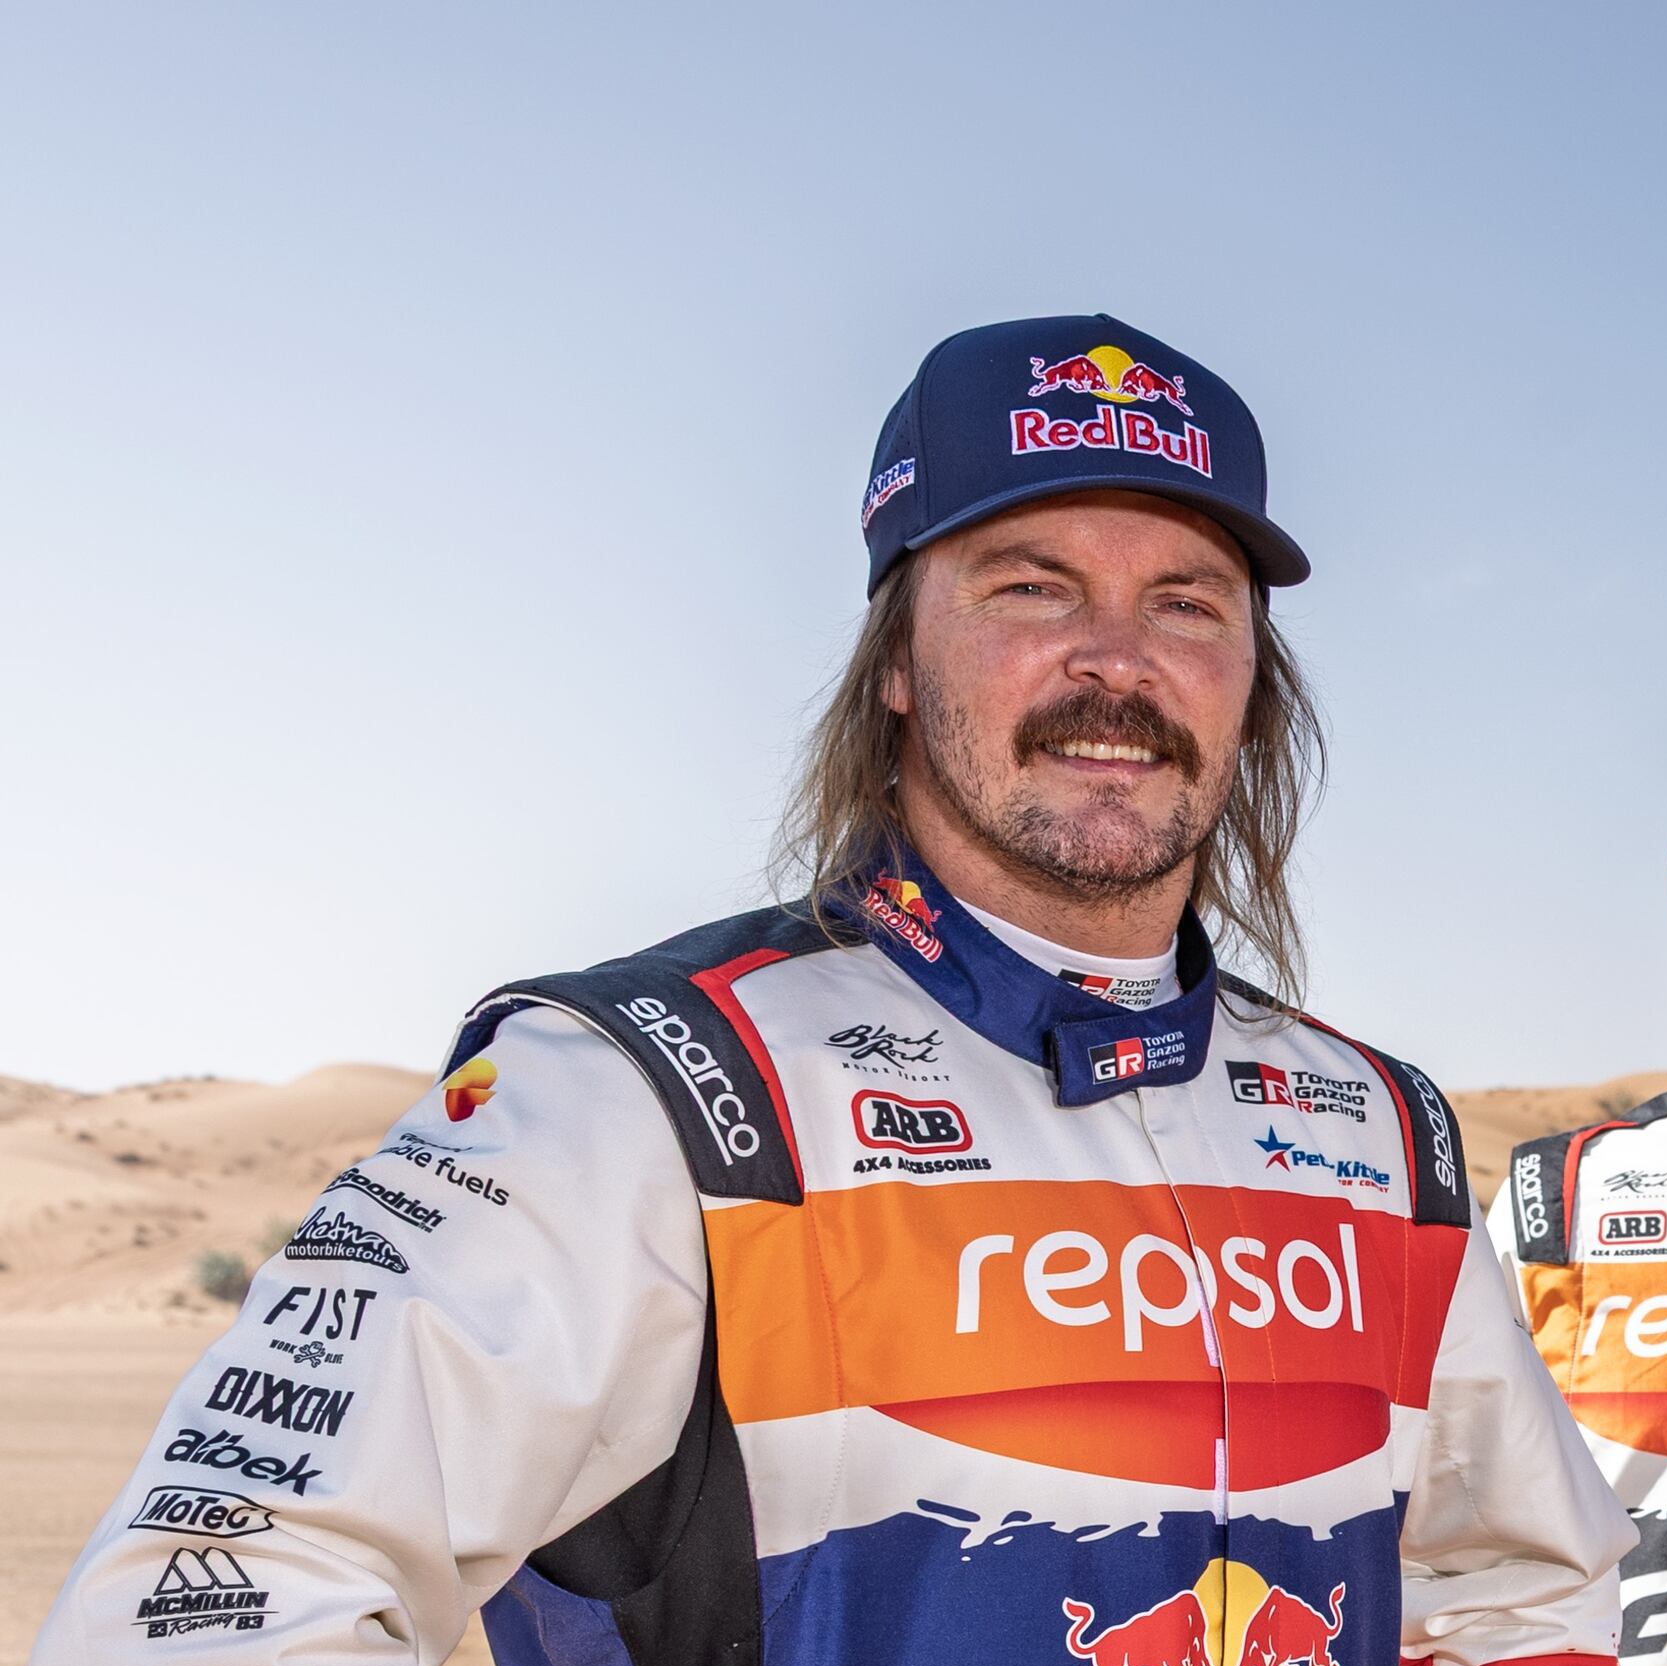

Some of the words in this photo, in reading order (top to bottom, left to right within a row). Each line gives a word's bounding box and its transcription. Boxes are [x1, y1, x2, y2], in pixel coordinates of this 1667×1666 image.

[1011, 404, 1120, 455] Red
[1122, 410, 1212, 478] Bull
[864, 886, 907, 929] Red
[896, 915, 944, 963] Bull
[1109, 987, 1156, 997] GAZOO
[824, 1024, 944, 1048] Black
[1143, 1031, 1184, 1048] TOYOTA
[1146, 1042, 1186, 1059] GAZOO
[850, 1038, 939, 1069] Rock
[1094, 1052, 1142, 1081] GR
[1147, 1055, 1186, 1071] Racing
[618, 997, 761, 1165] sparco
[1233, 1079, 1295, 1107] GR
[1291, 1071, 1371, 1093] TOYOTA
[1294, 1086, 1366, 1106] GAZOO
[871, 1100, 960, 1144] ARB
[1299, 1100, 1367, 1123] Racing
[1401, 1063, 1457, 1196] sparco
[853, 1156, 892, 1173] 4X4
[435, 1157, 510, 1207] fuels
[327, 1167, 445, 1228] Goodrich
[1514, 1153, 1549, 1243] sparco
[1606, 1216, 1661, 1239] ARB
[286, 1242, 404, 1273] motorbiketours
[955, 1223, 1364, 1353] repsol
[263, 1286, 378, 1341] FIST
[269, 1338, 300, 1355] WORK
[204, 1366, 355, 1437] DIXXON
[163, 1426, 324, 1497] albek
[168, 1612, 236, 1637] Racing
